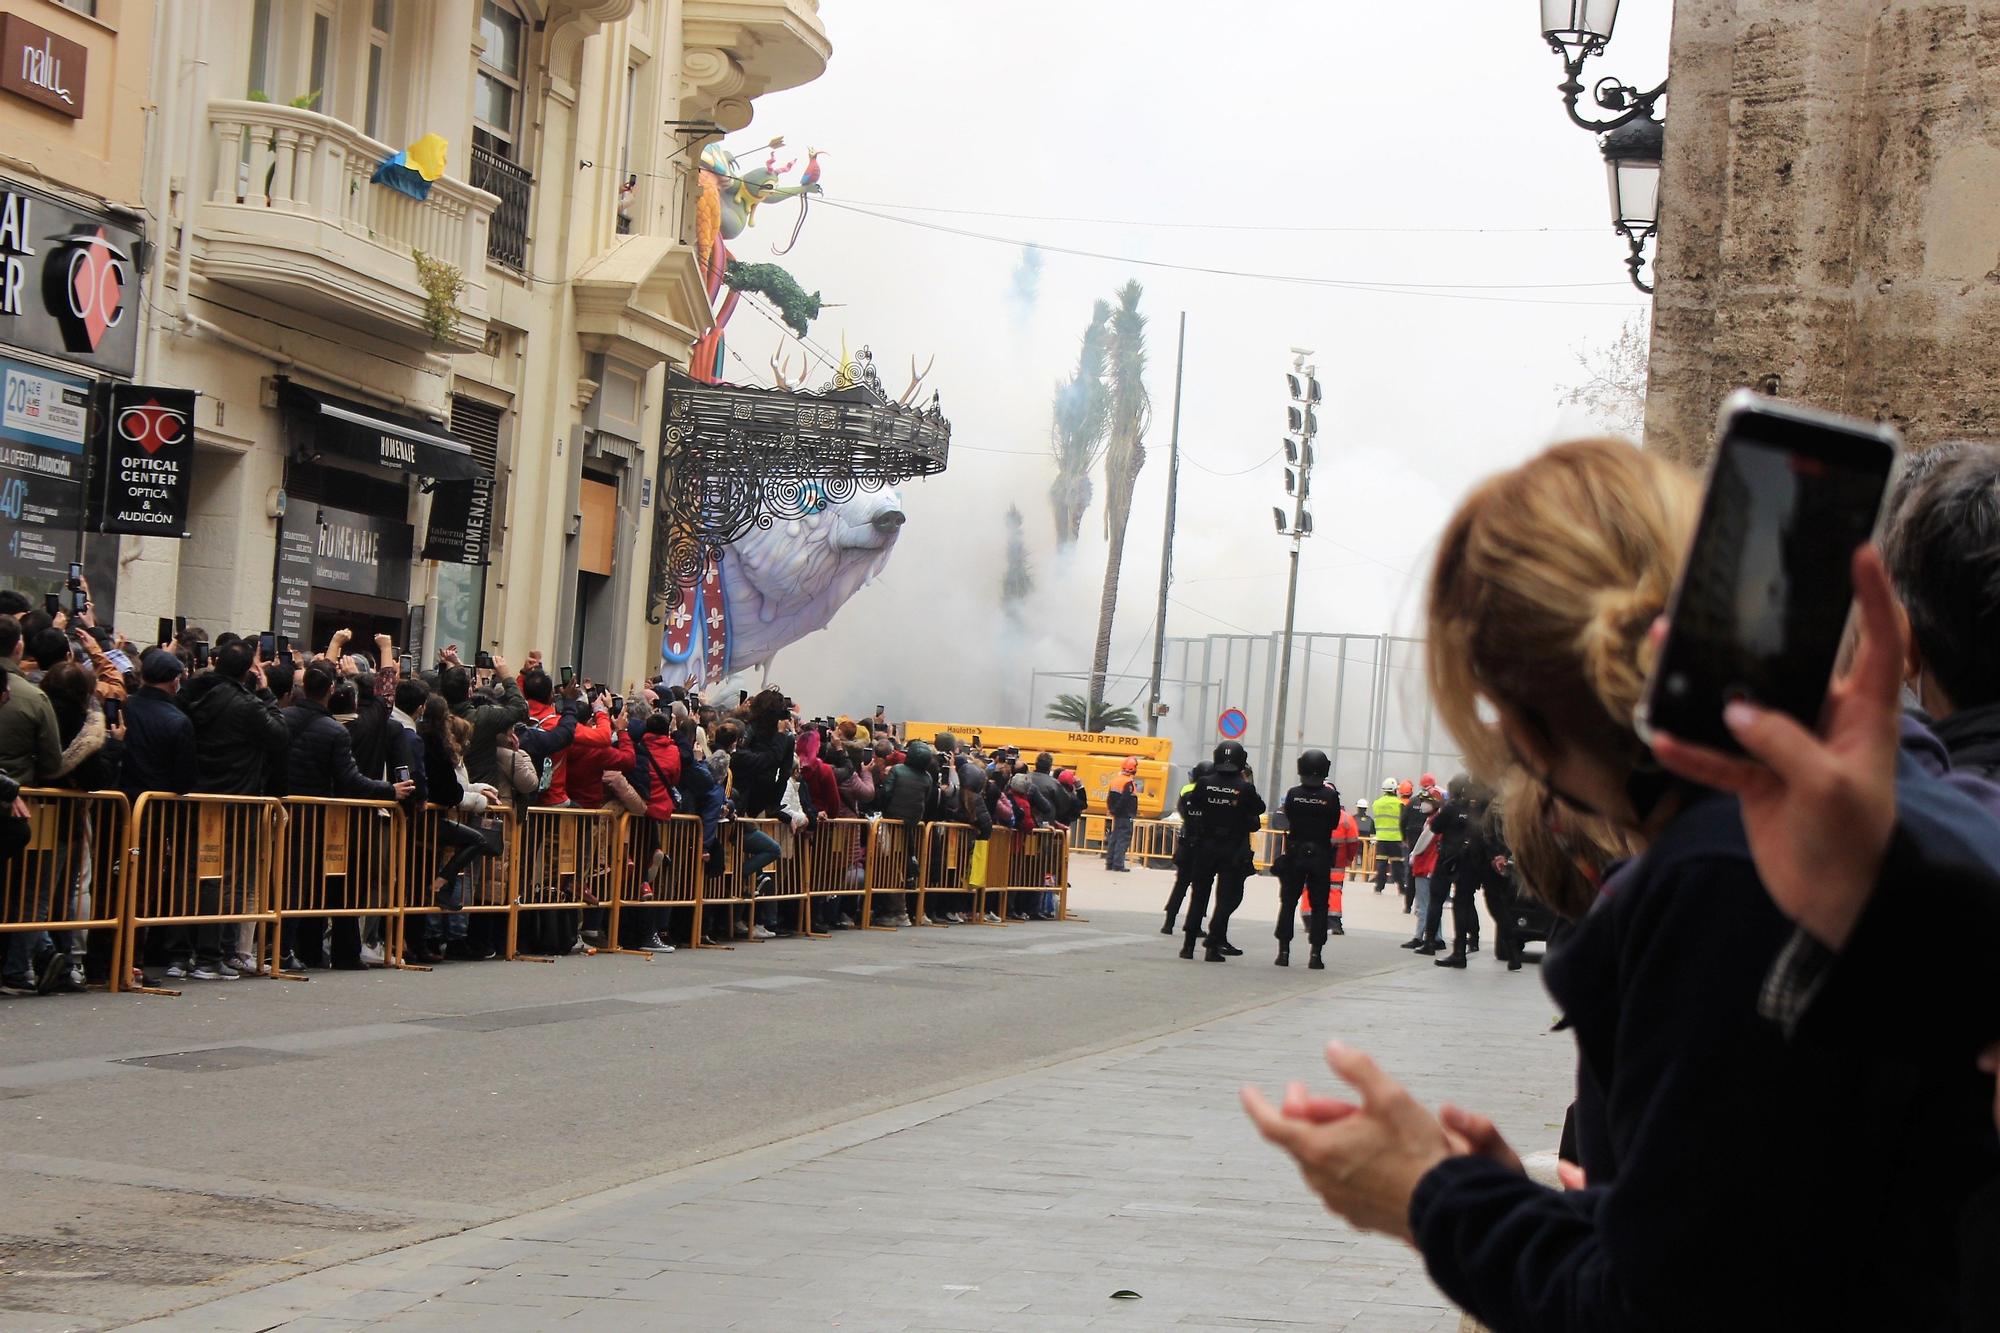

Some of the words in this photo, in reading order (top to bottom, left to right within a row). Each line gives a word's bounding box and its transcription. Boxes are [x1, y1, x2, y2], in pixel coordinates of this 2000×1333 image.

[11, 449, 37, 469] OFERTA
[37, 456, 71, 476] AUDICIÓN
[121, 457, 179, 472] OPTICAL
[120, 470, 177, 485] CENTER
[128, 486, 168, 499] OPTICA
[142, 500, 151, 510] &
[117, 511, 173, 524] AUDICIÓN
[462, 476, 490, 564] HOMENAJE
[317, 522, 380, 566] HOMENAJE
[947, 725, 977, 735] Haulotte
[1068, 733, 1094, 743] HA20
[1097, 735, 1115, 745] RTJ
[1118, 737, 1139, 746] PRO
